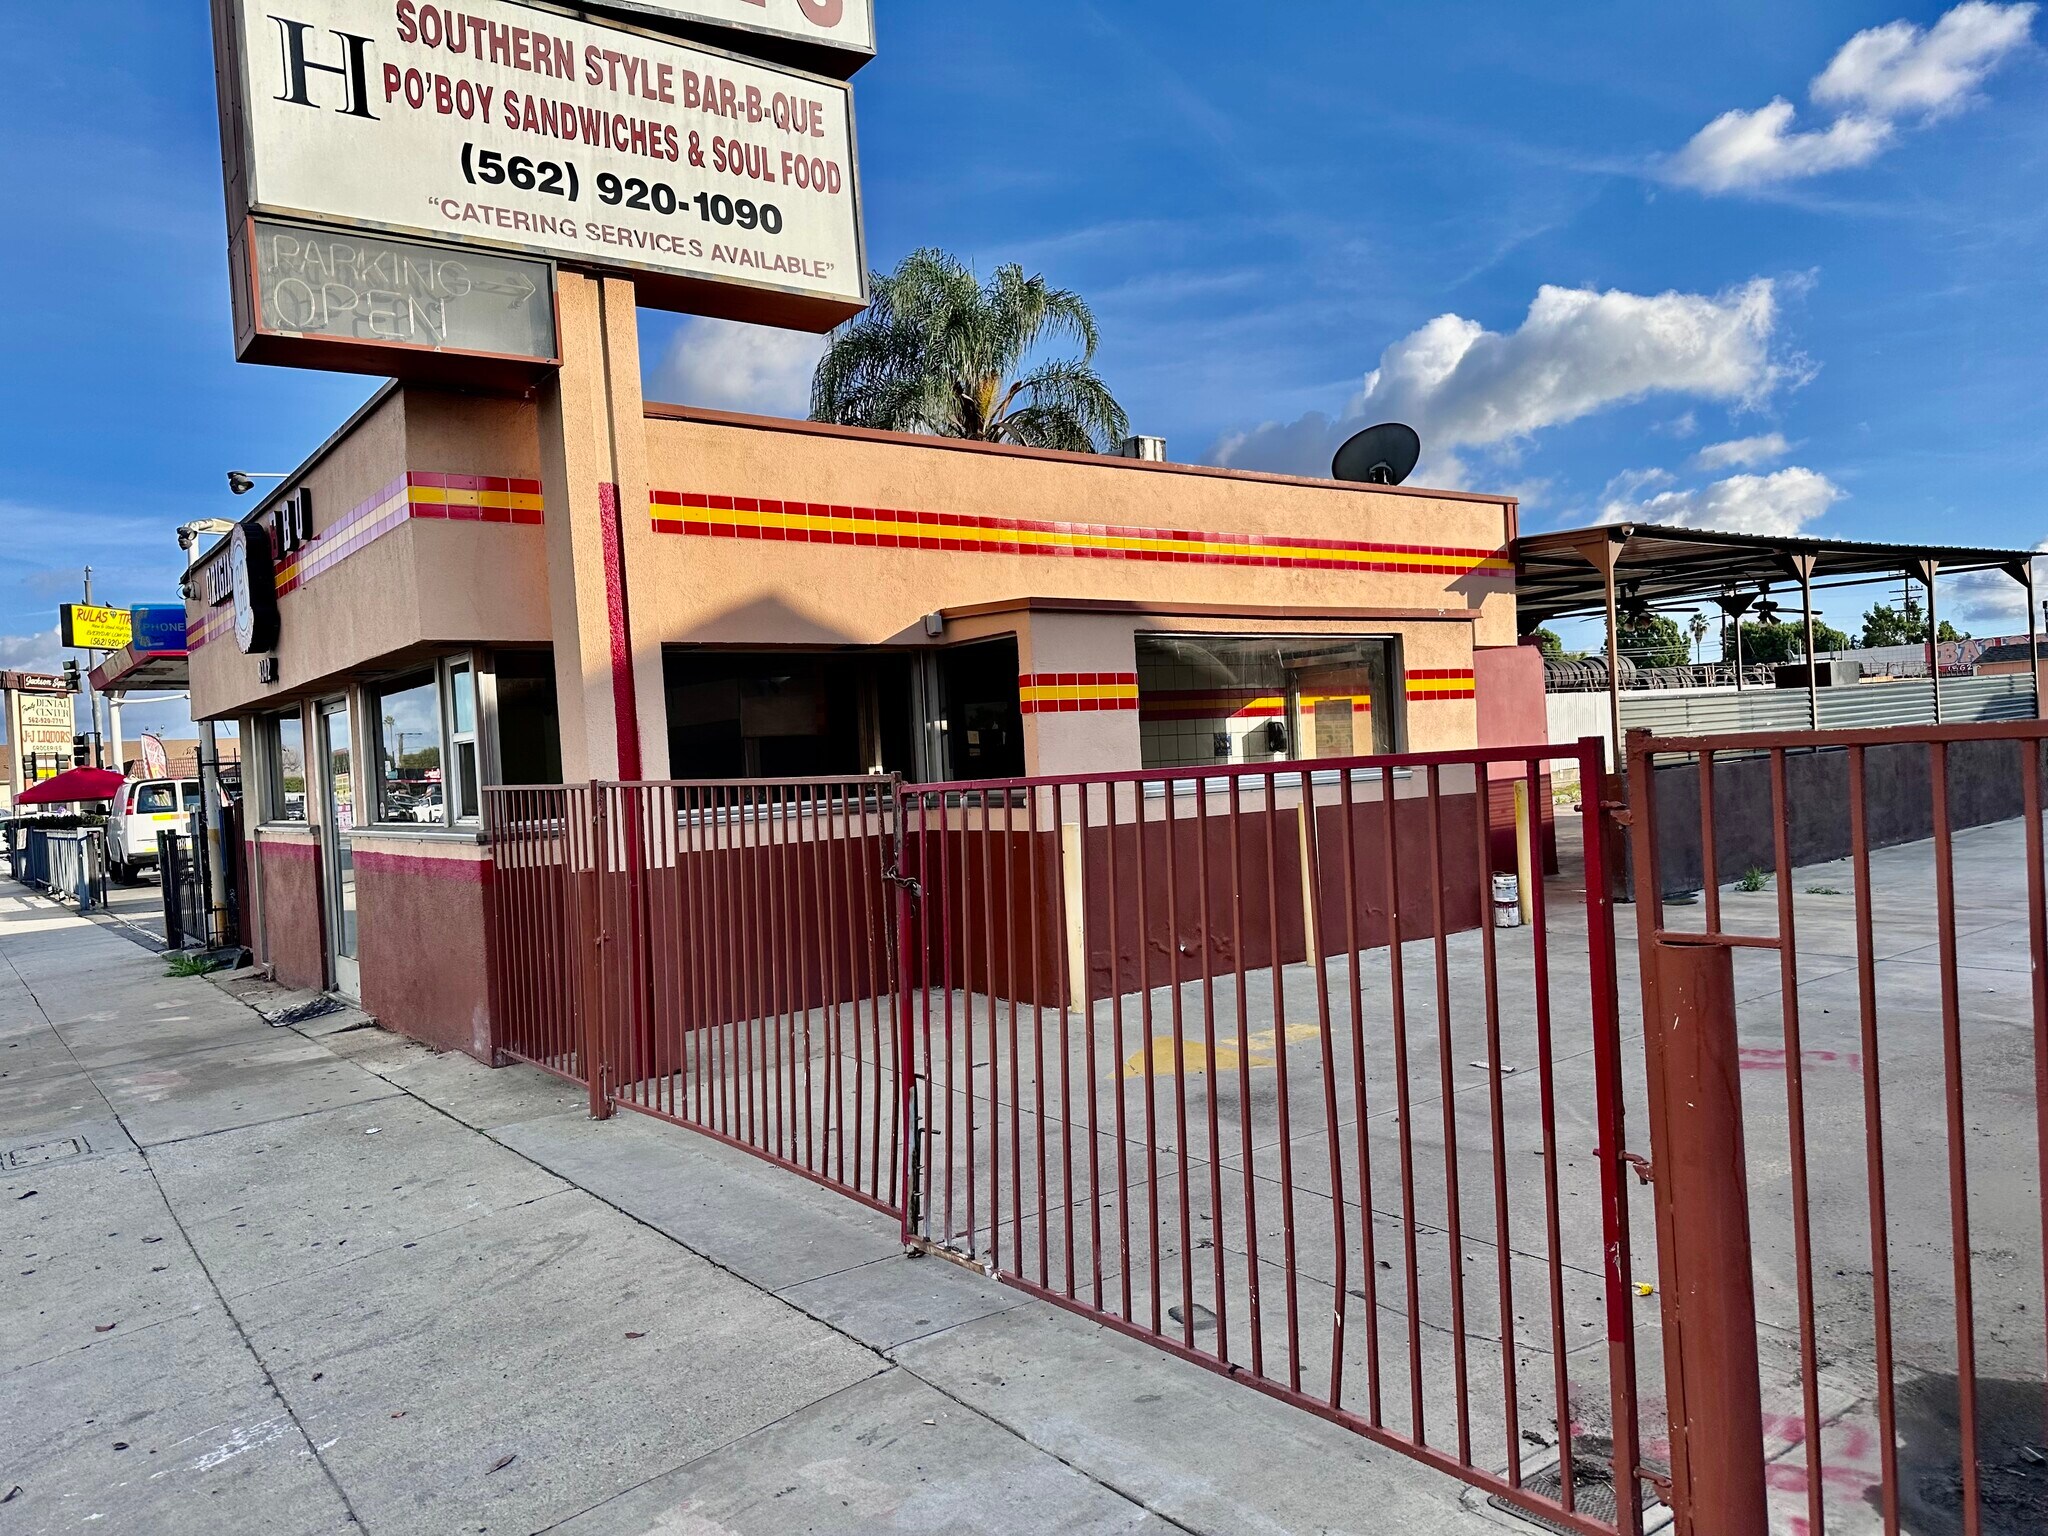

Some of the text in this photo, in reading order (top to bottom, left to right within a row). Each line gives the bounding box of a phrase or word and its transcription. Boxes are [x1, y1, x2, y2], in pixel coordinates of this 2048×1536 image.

[266, 15, 381, 121] H
[396, 0, 825, 137] SOUTHERN STYLE BAR-B-QUE
[383, 63, 841, 194] PO'BOY SANDWICHES & SOUL FOOD
[461, 142, 783, 235] (562) 920-1090
[273, 234, 471, 297] PARKING
[428, 196, 835, 279] "CATERING SERVICES AVAILABLE"
[273, 277, 447, 342] OPEN
[206, 552, 233, 607] ORIGIN
[76, 608, 132, 625] RULAS TIR
[143, 622, 185, 632] PHONE
[26, 675, 67, 689] Jackson Squ
[36, 698, 69, 708] DENTAL
[36, 708, 69, 717] CENTER
[37, 730, 71, 743] LIQUORS
